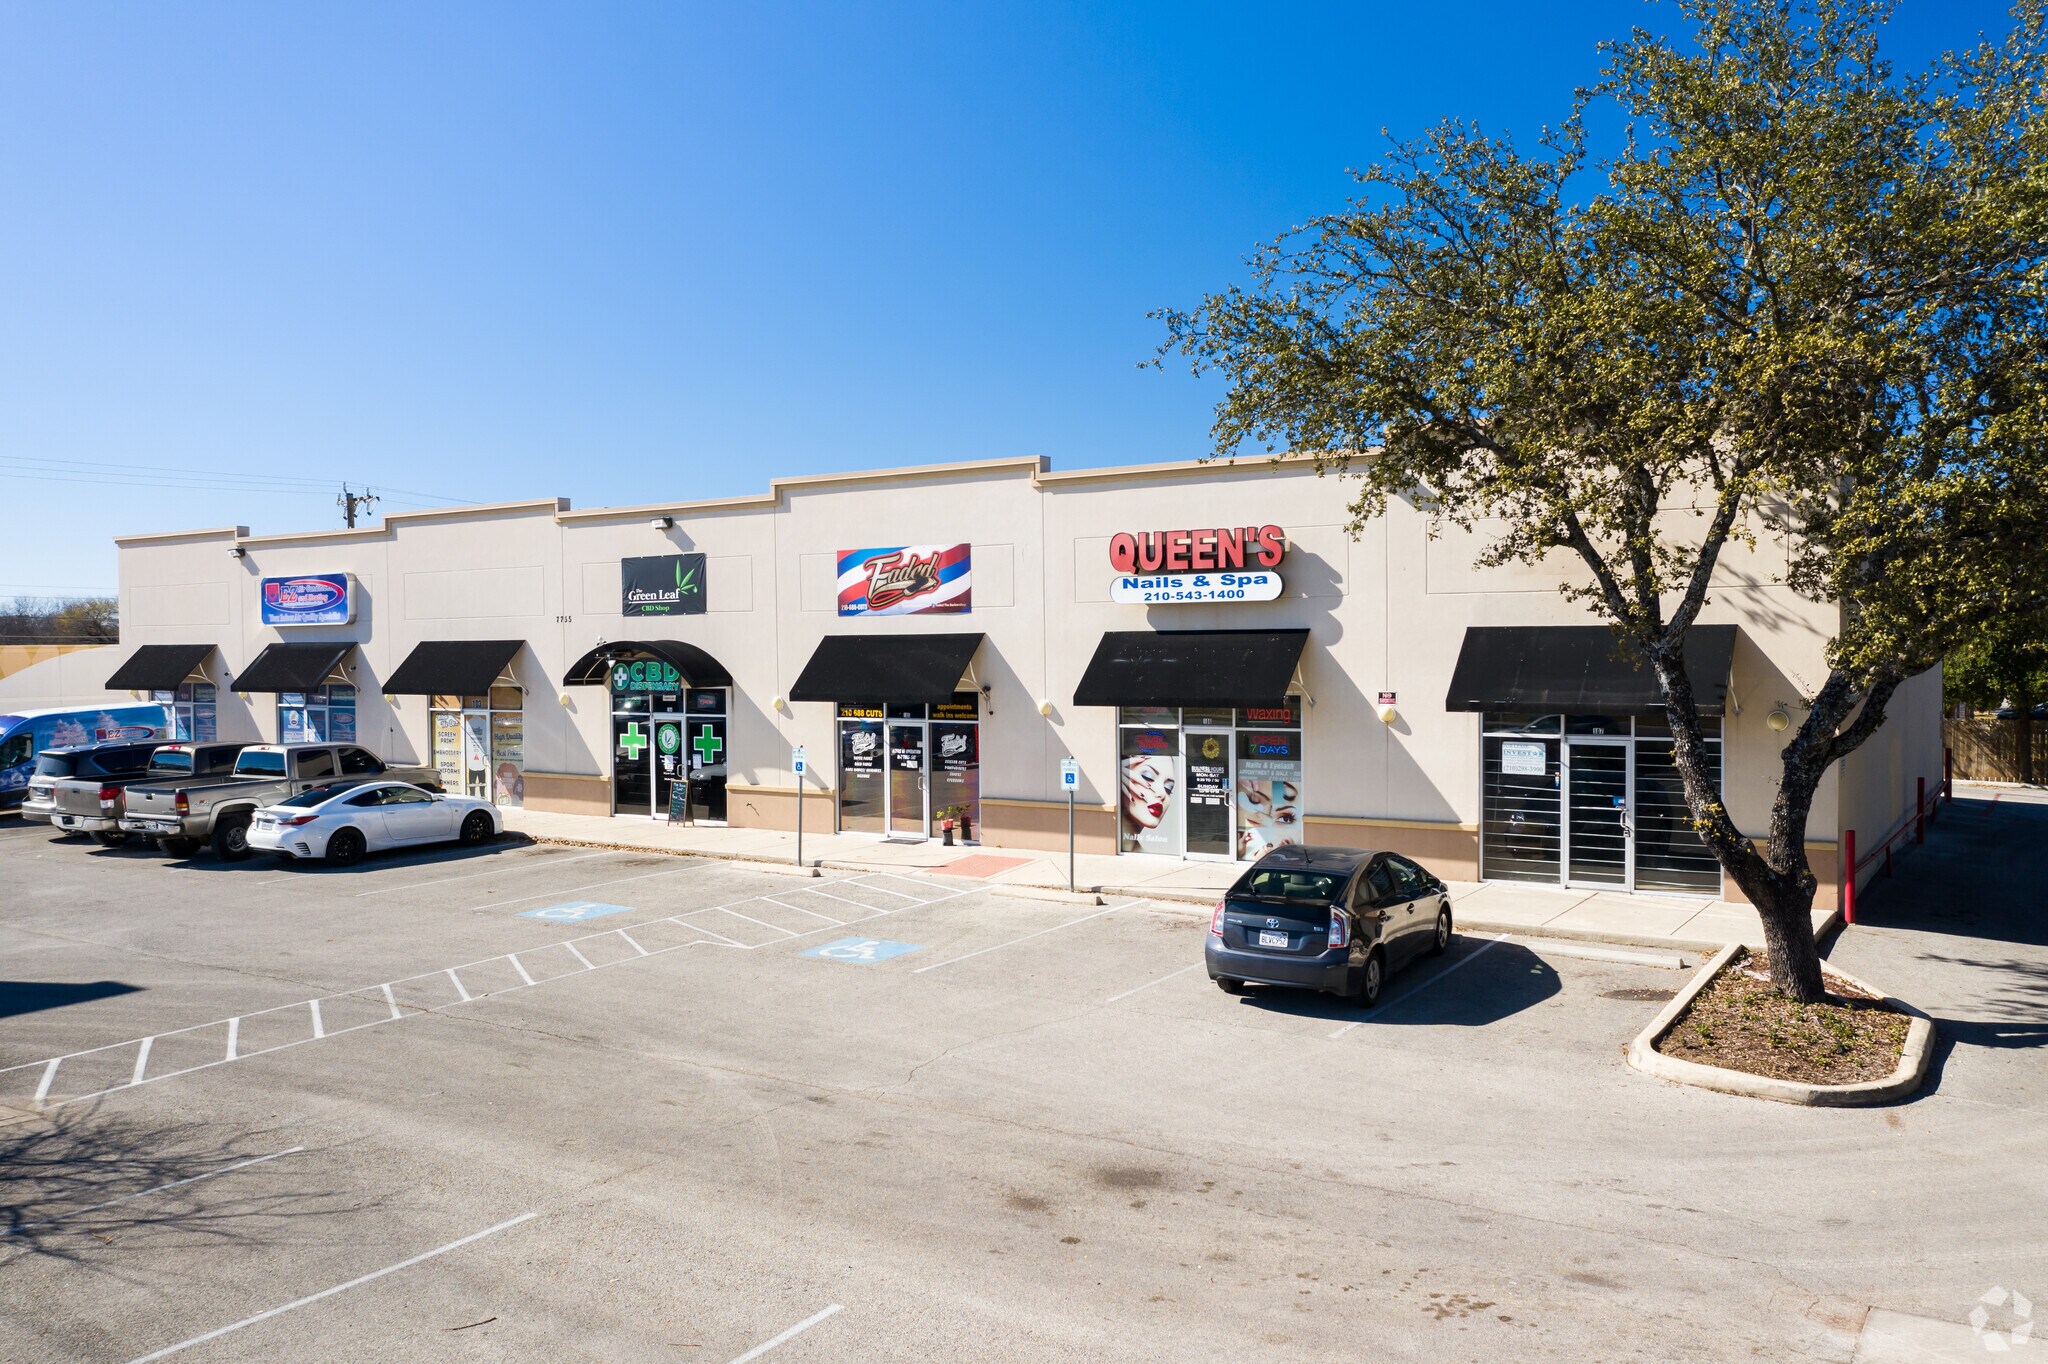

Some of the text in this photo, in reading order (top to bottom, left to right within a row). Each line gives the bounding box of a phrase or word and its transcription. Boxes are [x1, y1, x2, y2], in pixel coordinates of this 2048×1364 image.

[1109, 524, 1285, 574] QUEEN'S
[864, 552, 940, 605] Faded
[1123, 574, 1268, 589] Nails & Spa
[280, 586, 298, 603] EZ
[628, 588, 680, 601] Green Leaf
[1144, 590, 1245, 601] 210-543-1400
[630, 661, 680, 682] CBD
[630, 682, 680, 691] DISPENSARY
[937, 703, 972, 711] appointments
[841, 708, 852, 717] 210
[866, 709, 883, 718] CUTS
[1247, 708, 1291, 724] Waxing
[107, 729, 121, 739] EZ
[494, 732, 524, 743] High Quality
[1251, 735, 1287, 745] OPEN
[1250, 744, 1288, 755] 7 DAYS
[1245, 761, 1262, 769] Nails
[1123, 832, 1169, 843] Nails Salon
